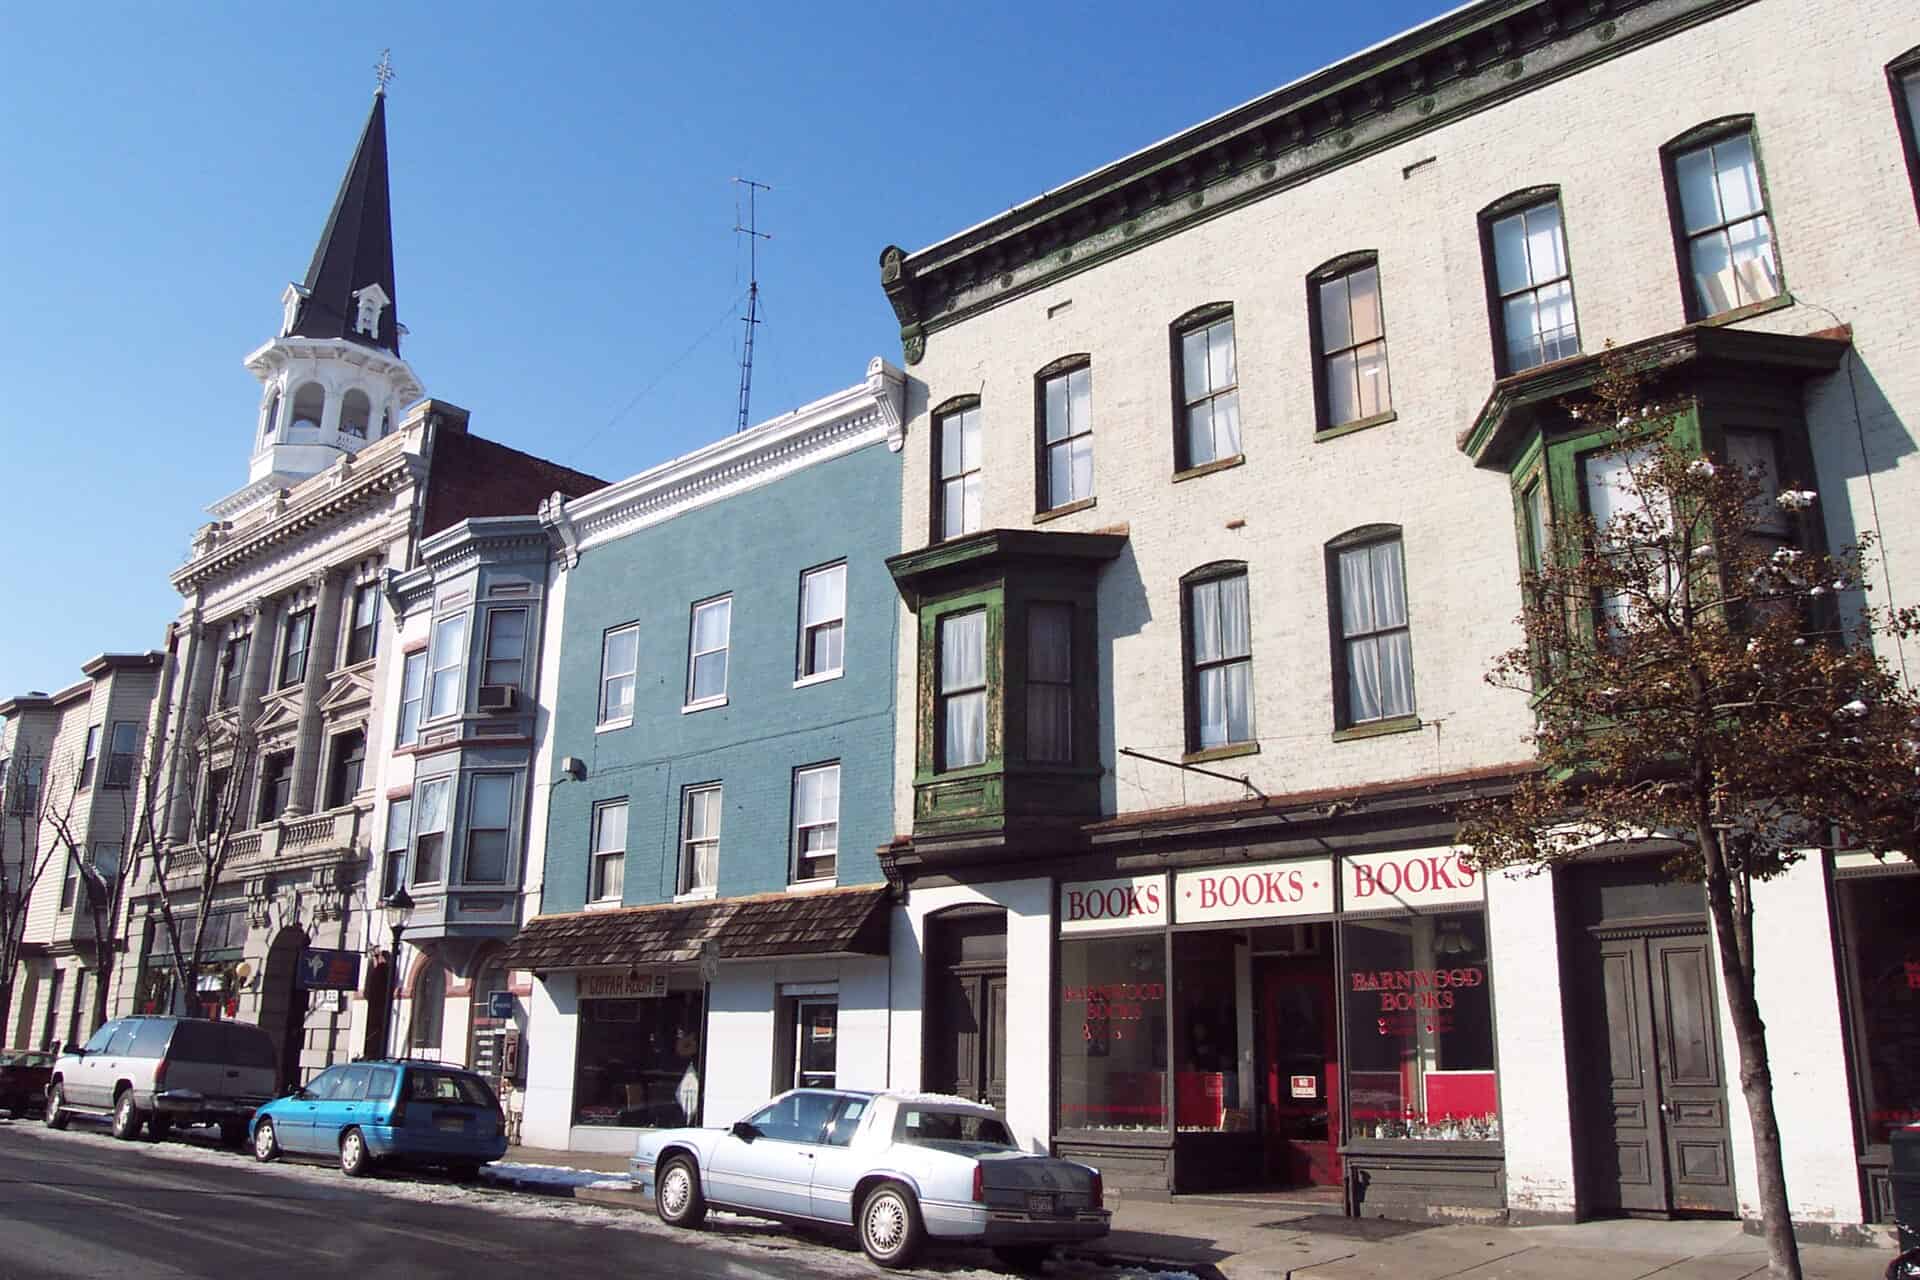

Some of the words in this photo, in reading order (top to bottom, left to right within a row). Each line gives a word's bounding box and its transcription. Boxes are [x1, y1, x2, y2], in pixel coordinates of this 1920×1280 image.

[1199, 870, 1304, 909] BOOKS
[1353, 853, 1475, 897] BOOKS
[1068, 884, 1160, 920] BOOKS
[1351, 967, 1482, 991] BARNWOOD
[1381, 991, 1454, 1011] BOOKS
